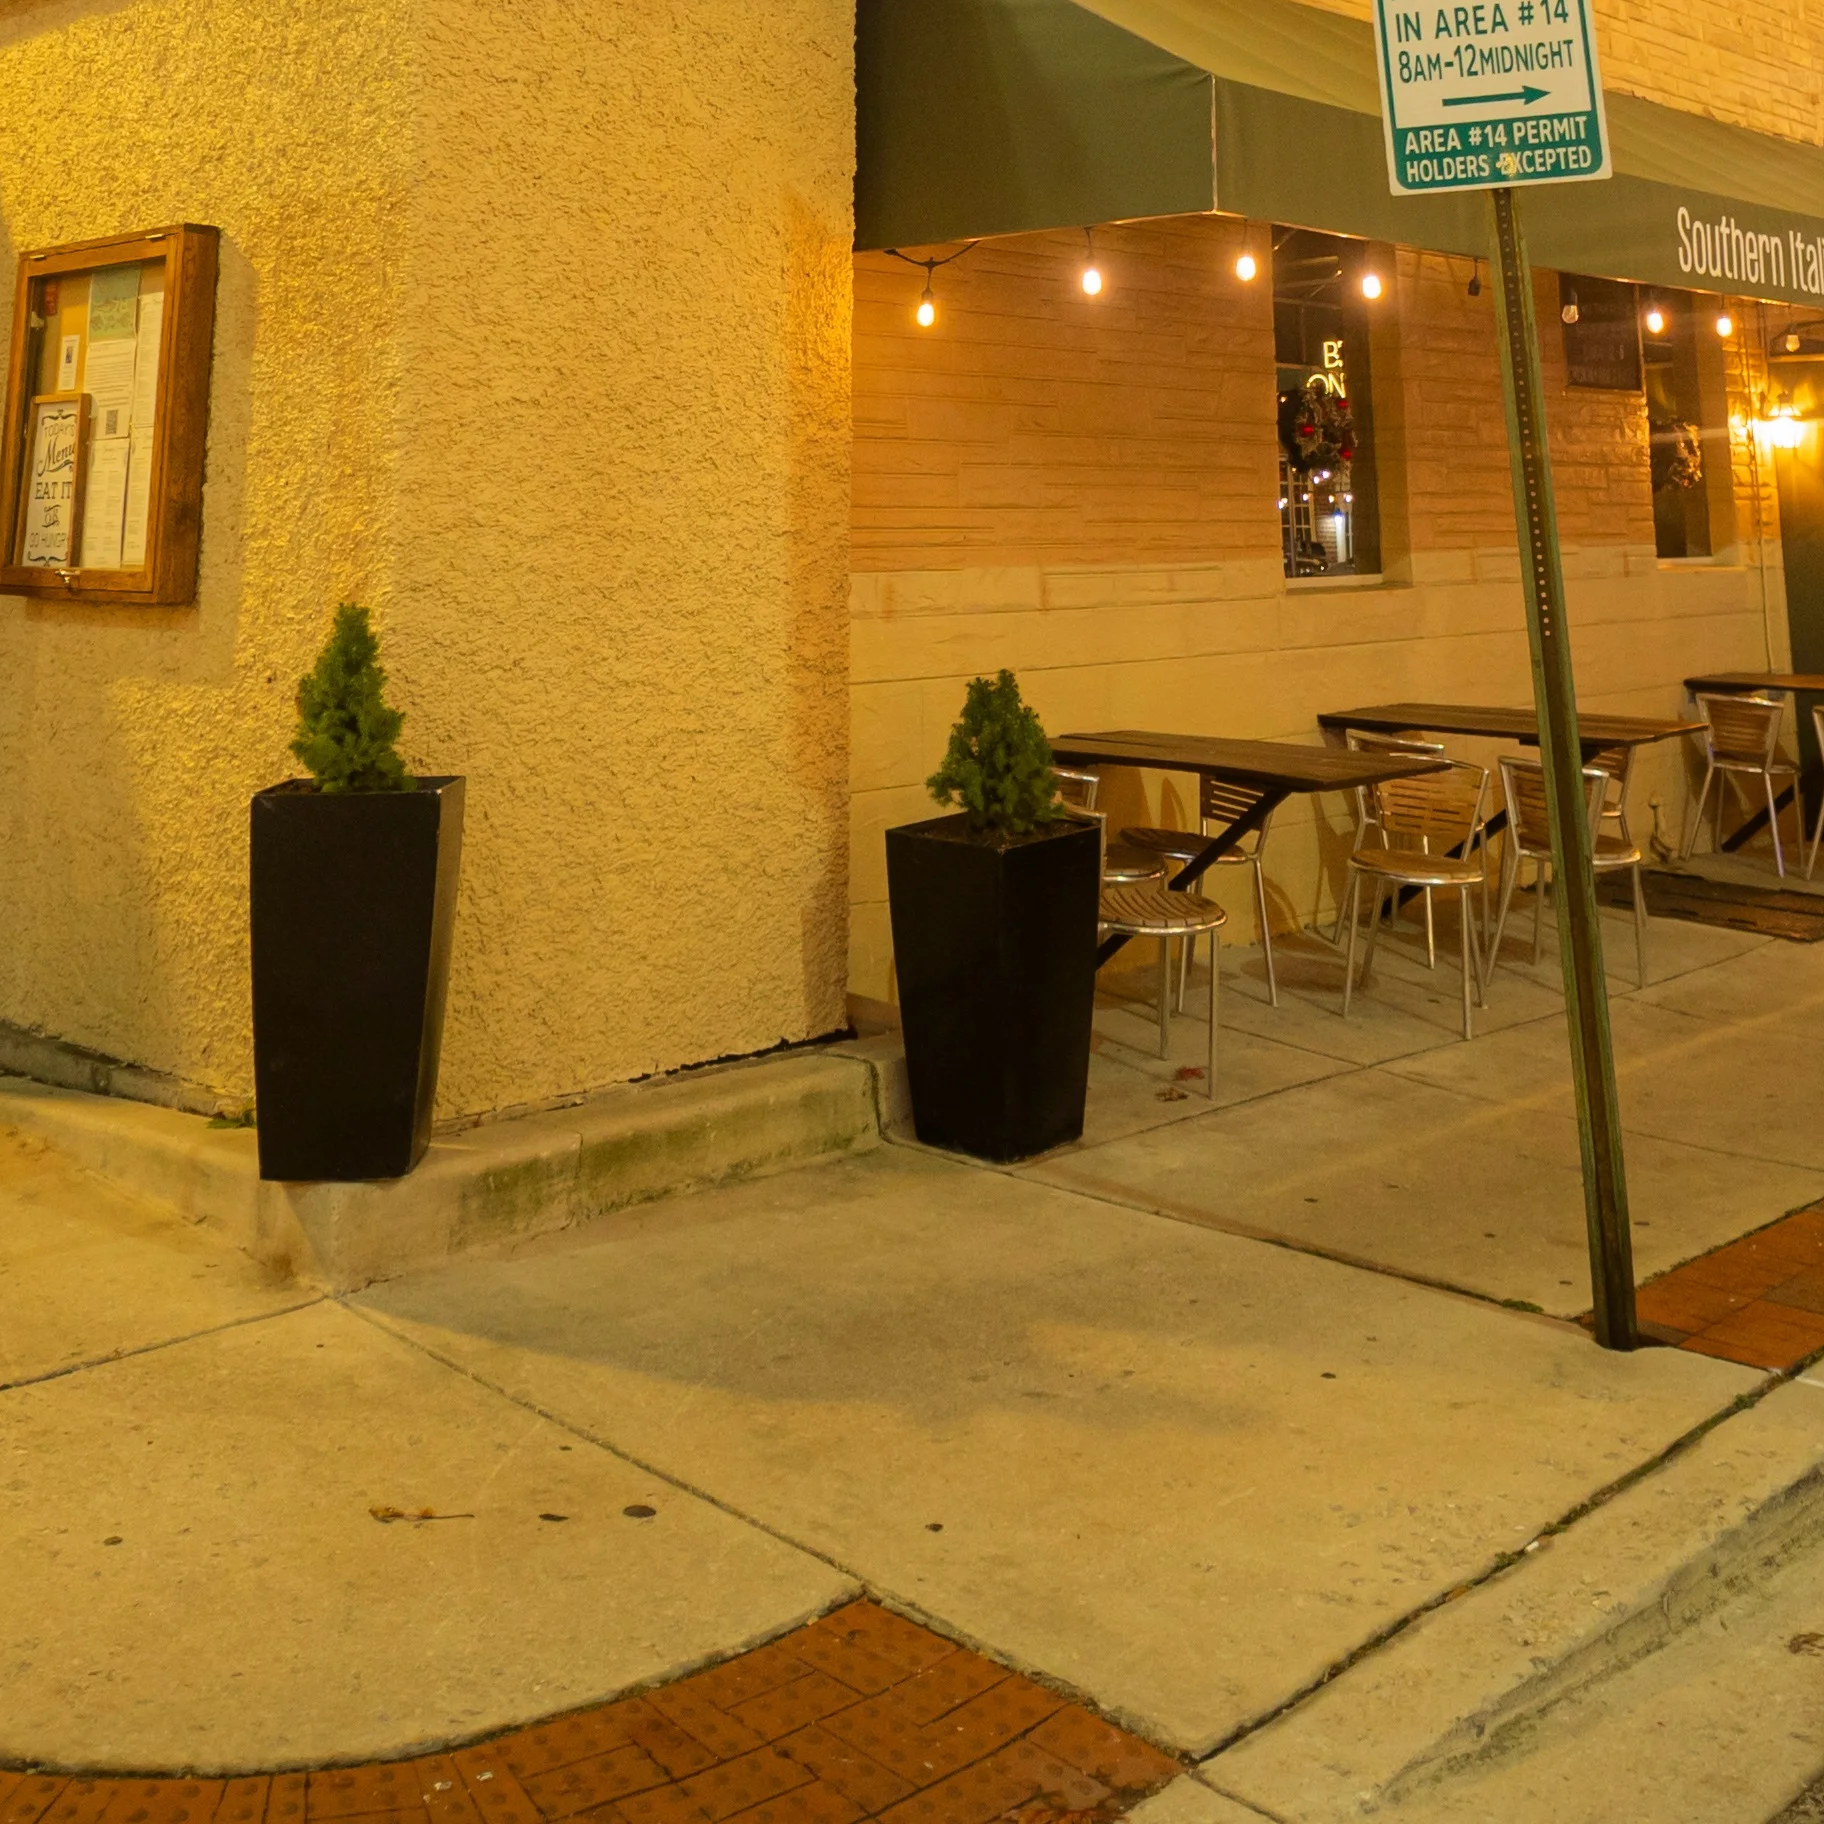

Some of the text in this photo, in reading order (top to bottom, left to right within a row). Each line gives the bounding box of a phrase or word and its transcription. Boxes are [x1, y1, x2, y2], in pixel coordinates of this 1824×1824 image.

[1395, 11, 1422, 43] IN
[1435, 3, 1509, 39] AREA
[1398, 39, 1574, 84] 8AM-12MIDNIGHT
[1405, 116, 1587, 155] AREA #14 PERMIT
[1406, 145, 1592, 183] HOLDERS EXCEPTED
[1677, 206, 1785, 288] Southern
[35, 482, 58, 500] EAT
